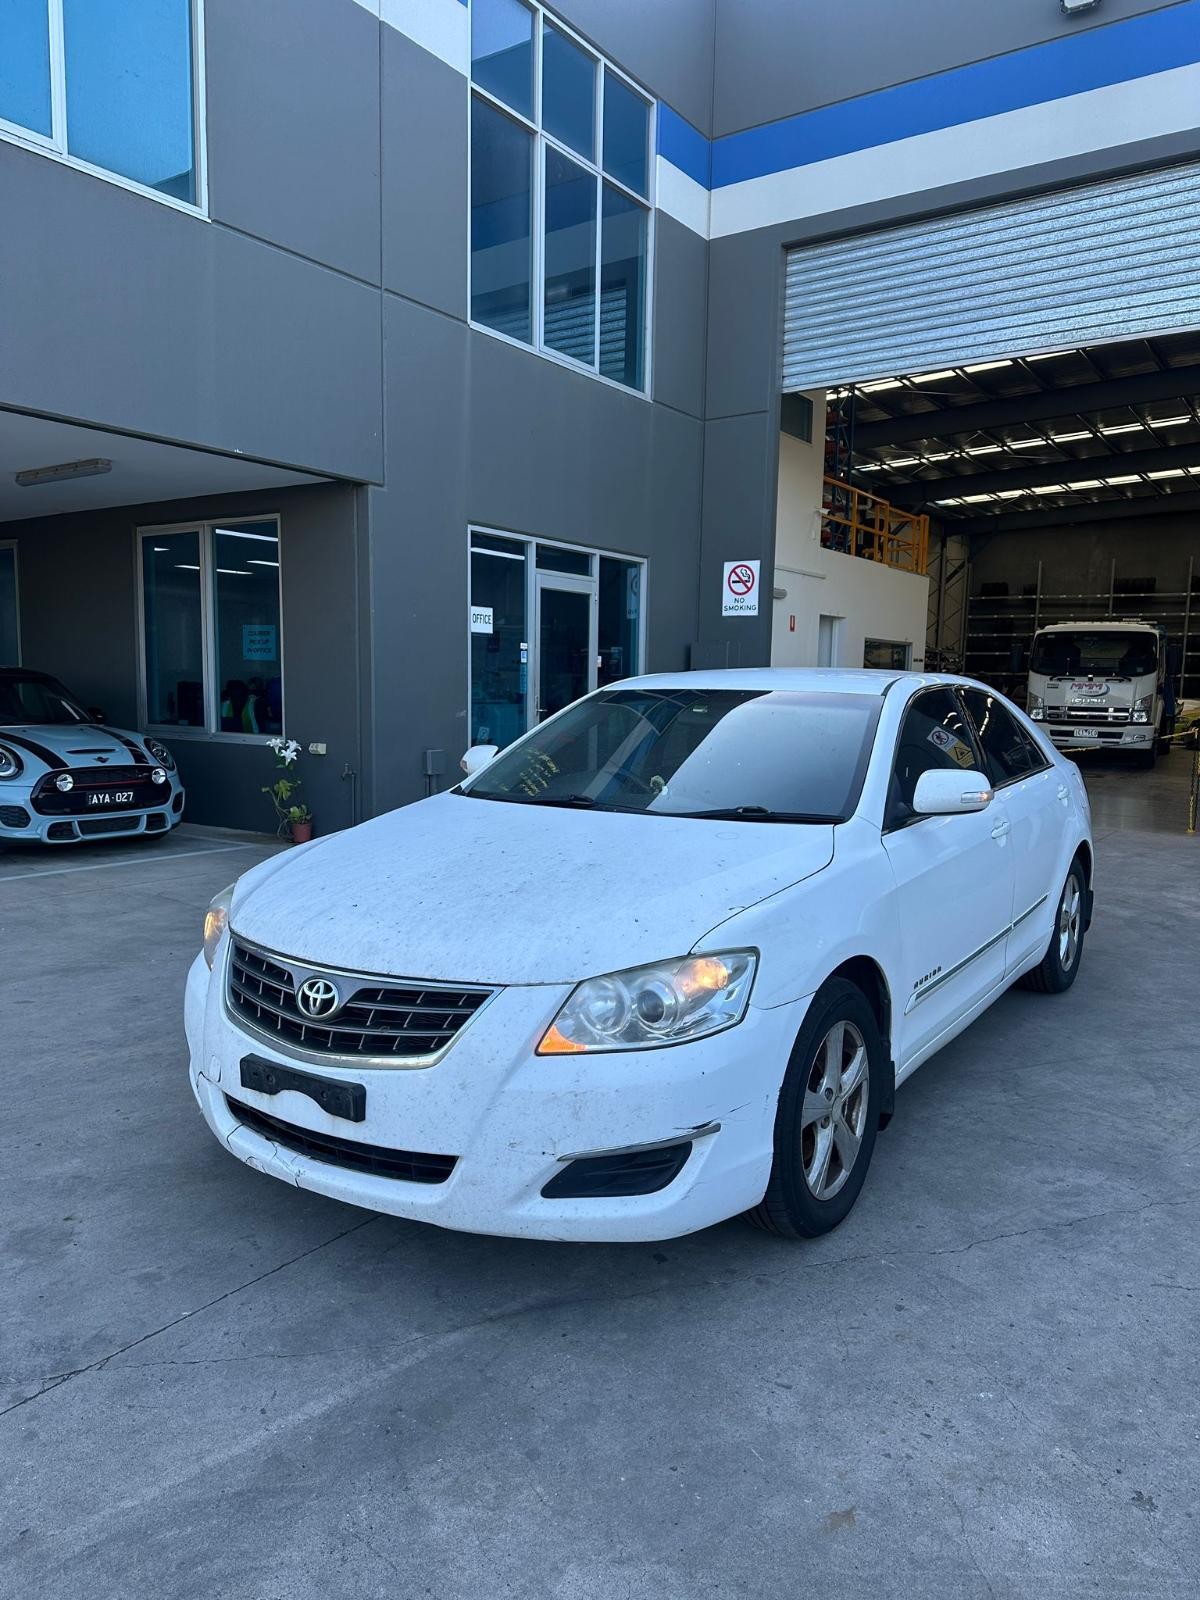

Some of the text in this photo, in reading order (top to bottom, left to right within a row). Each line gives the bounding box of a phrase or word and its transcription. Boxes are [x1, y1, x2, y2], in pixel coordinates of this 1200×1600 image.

[723, 604, 757, 612] SMOKING
[472, 613, 492, 625] OFFICE
[913, 965, 942, 990] AURION
